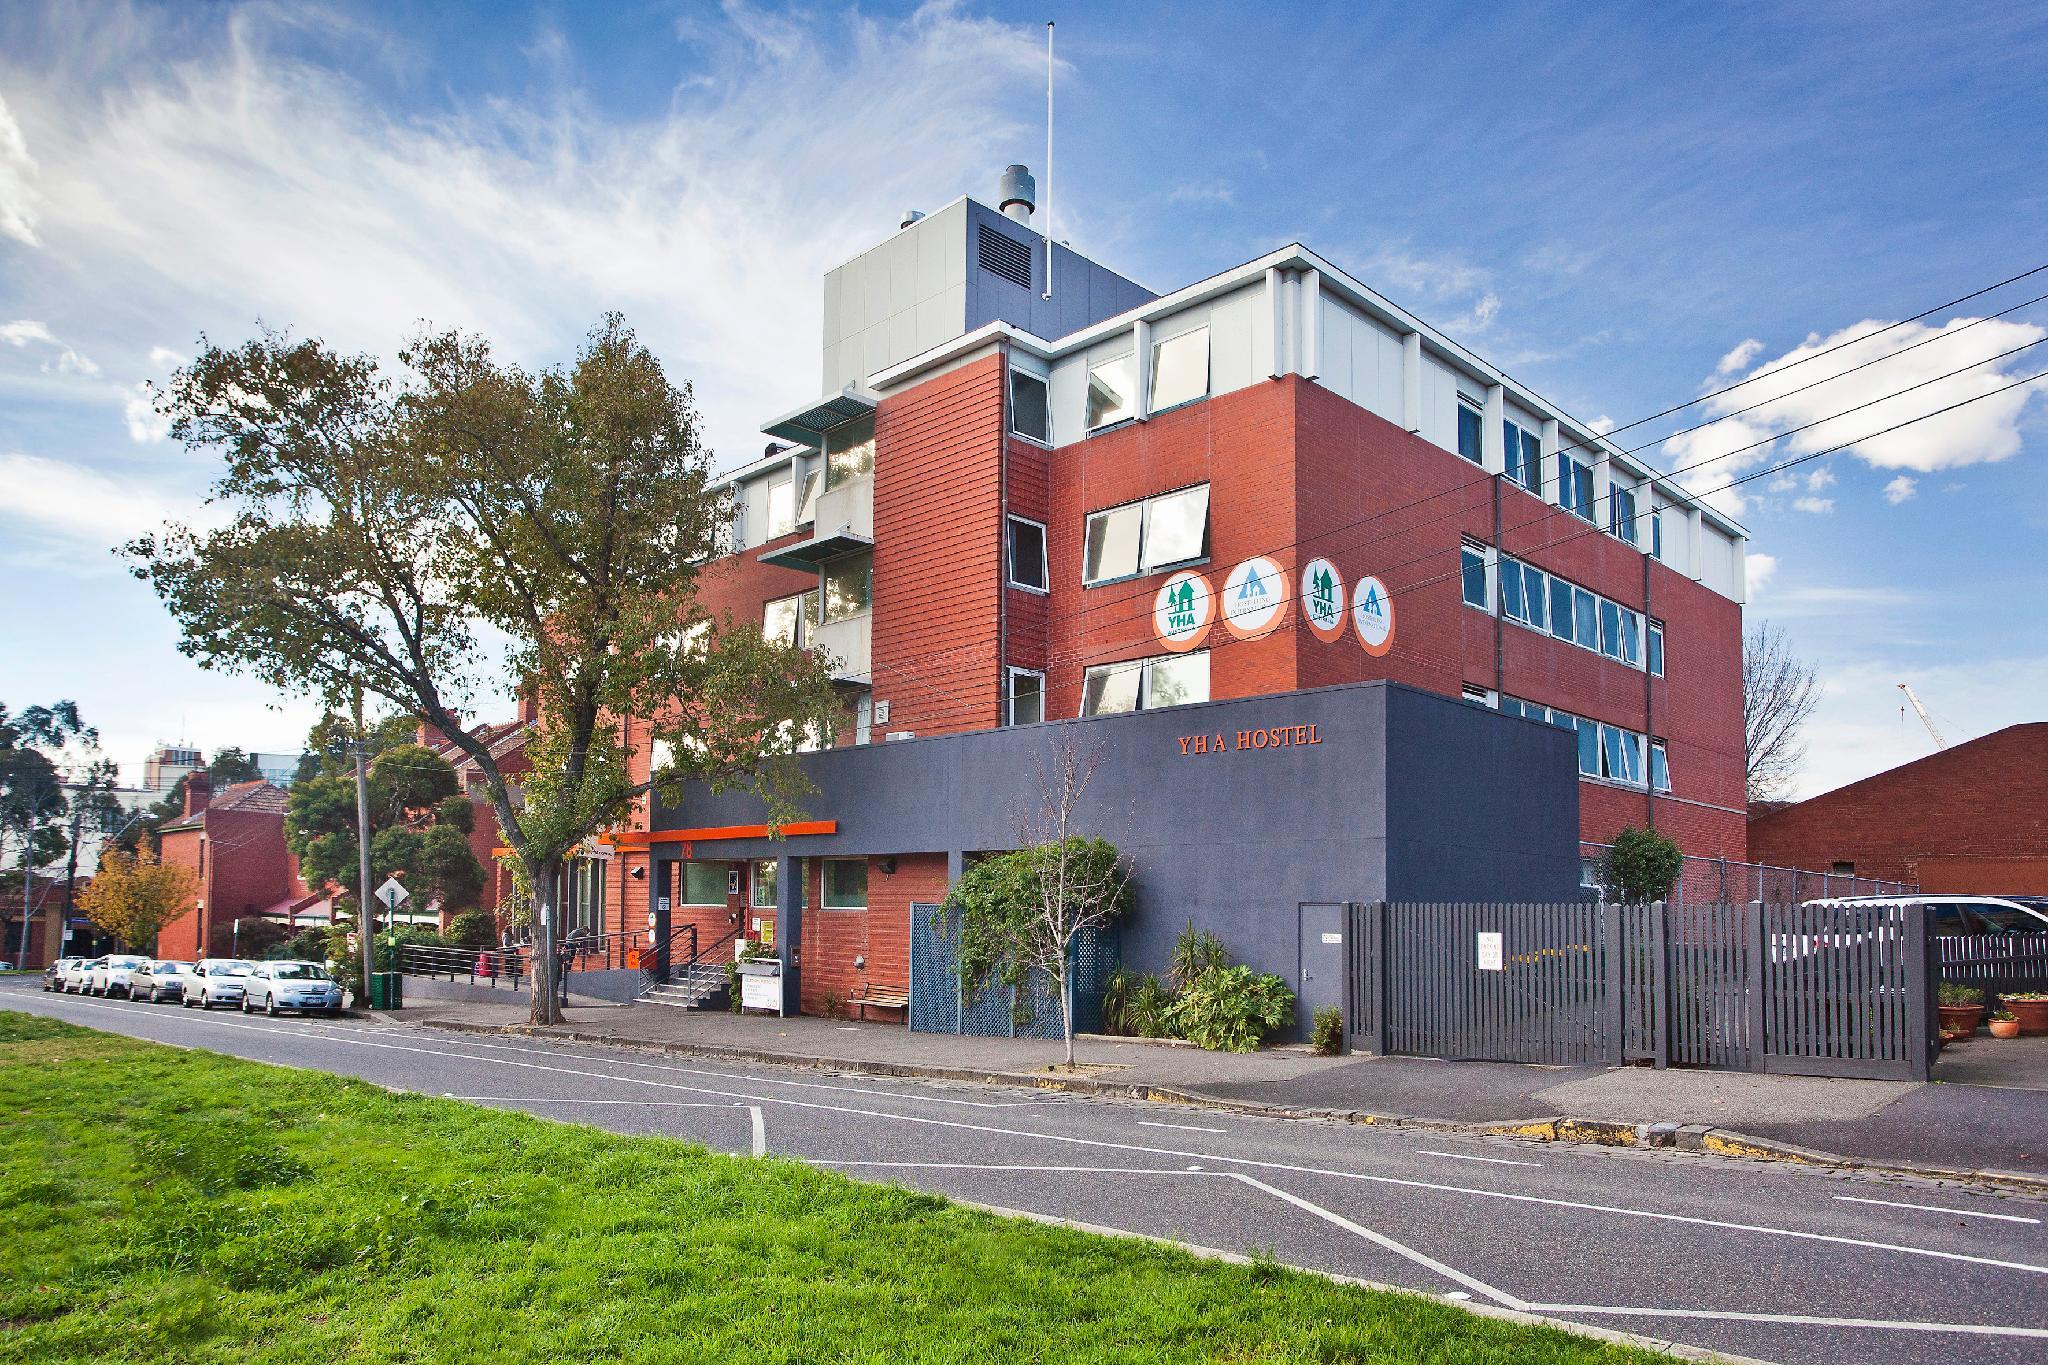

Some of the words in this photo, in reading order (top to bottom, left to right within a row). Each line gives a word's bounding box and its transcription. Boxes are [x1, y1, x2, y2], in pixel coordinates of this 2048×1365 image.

[1313, 600, 1334, 618] YHA
[1168, 613, 1195, 628] YHA
[1177, 734, 1227, 756] YHA
[1235, 724, 1323, 751] HOSTEL
[681, 841, 693, 859] 78
